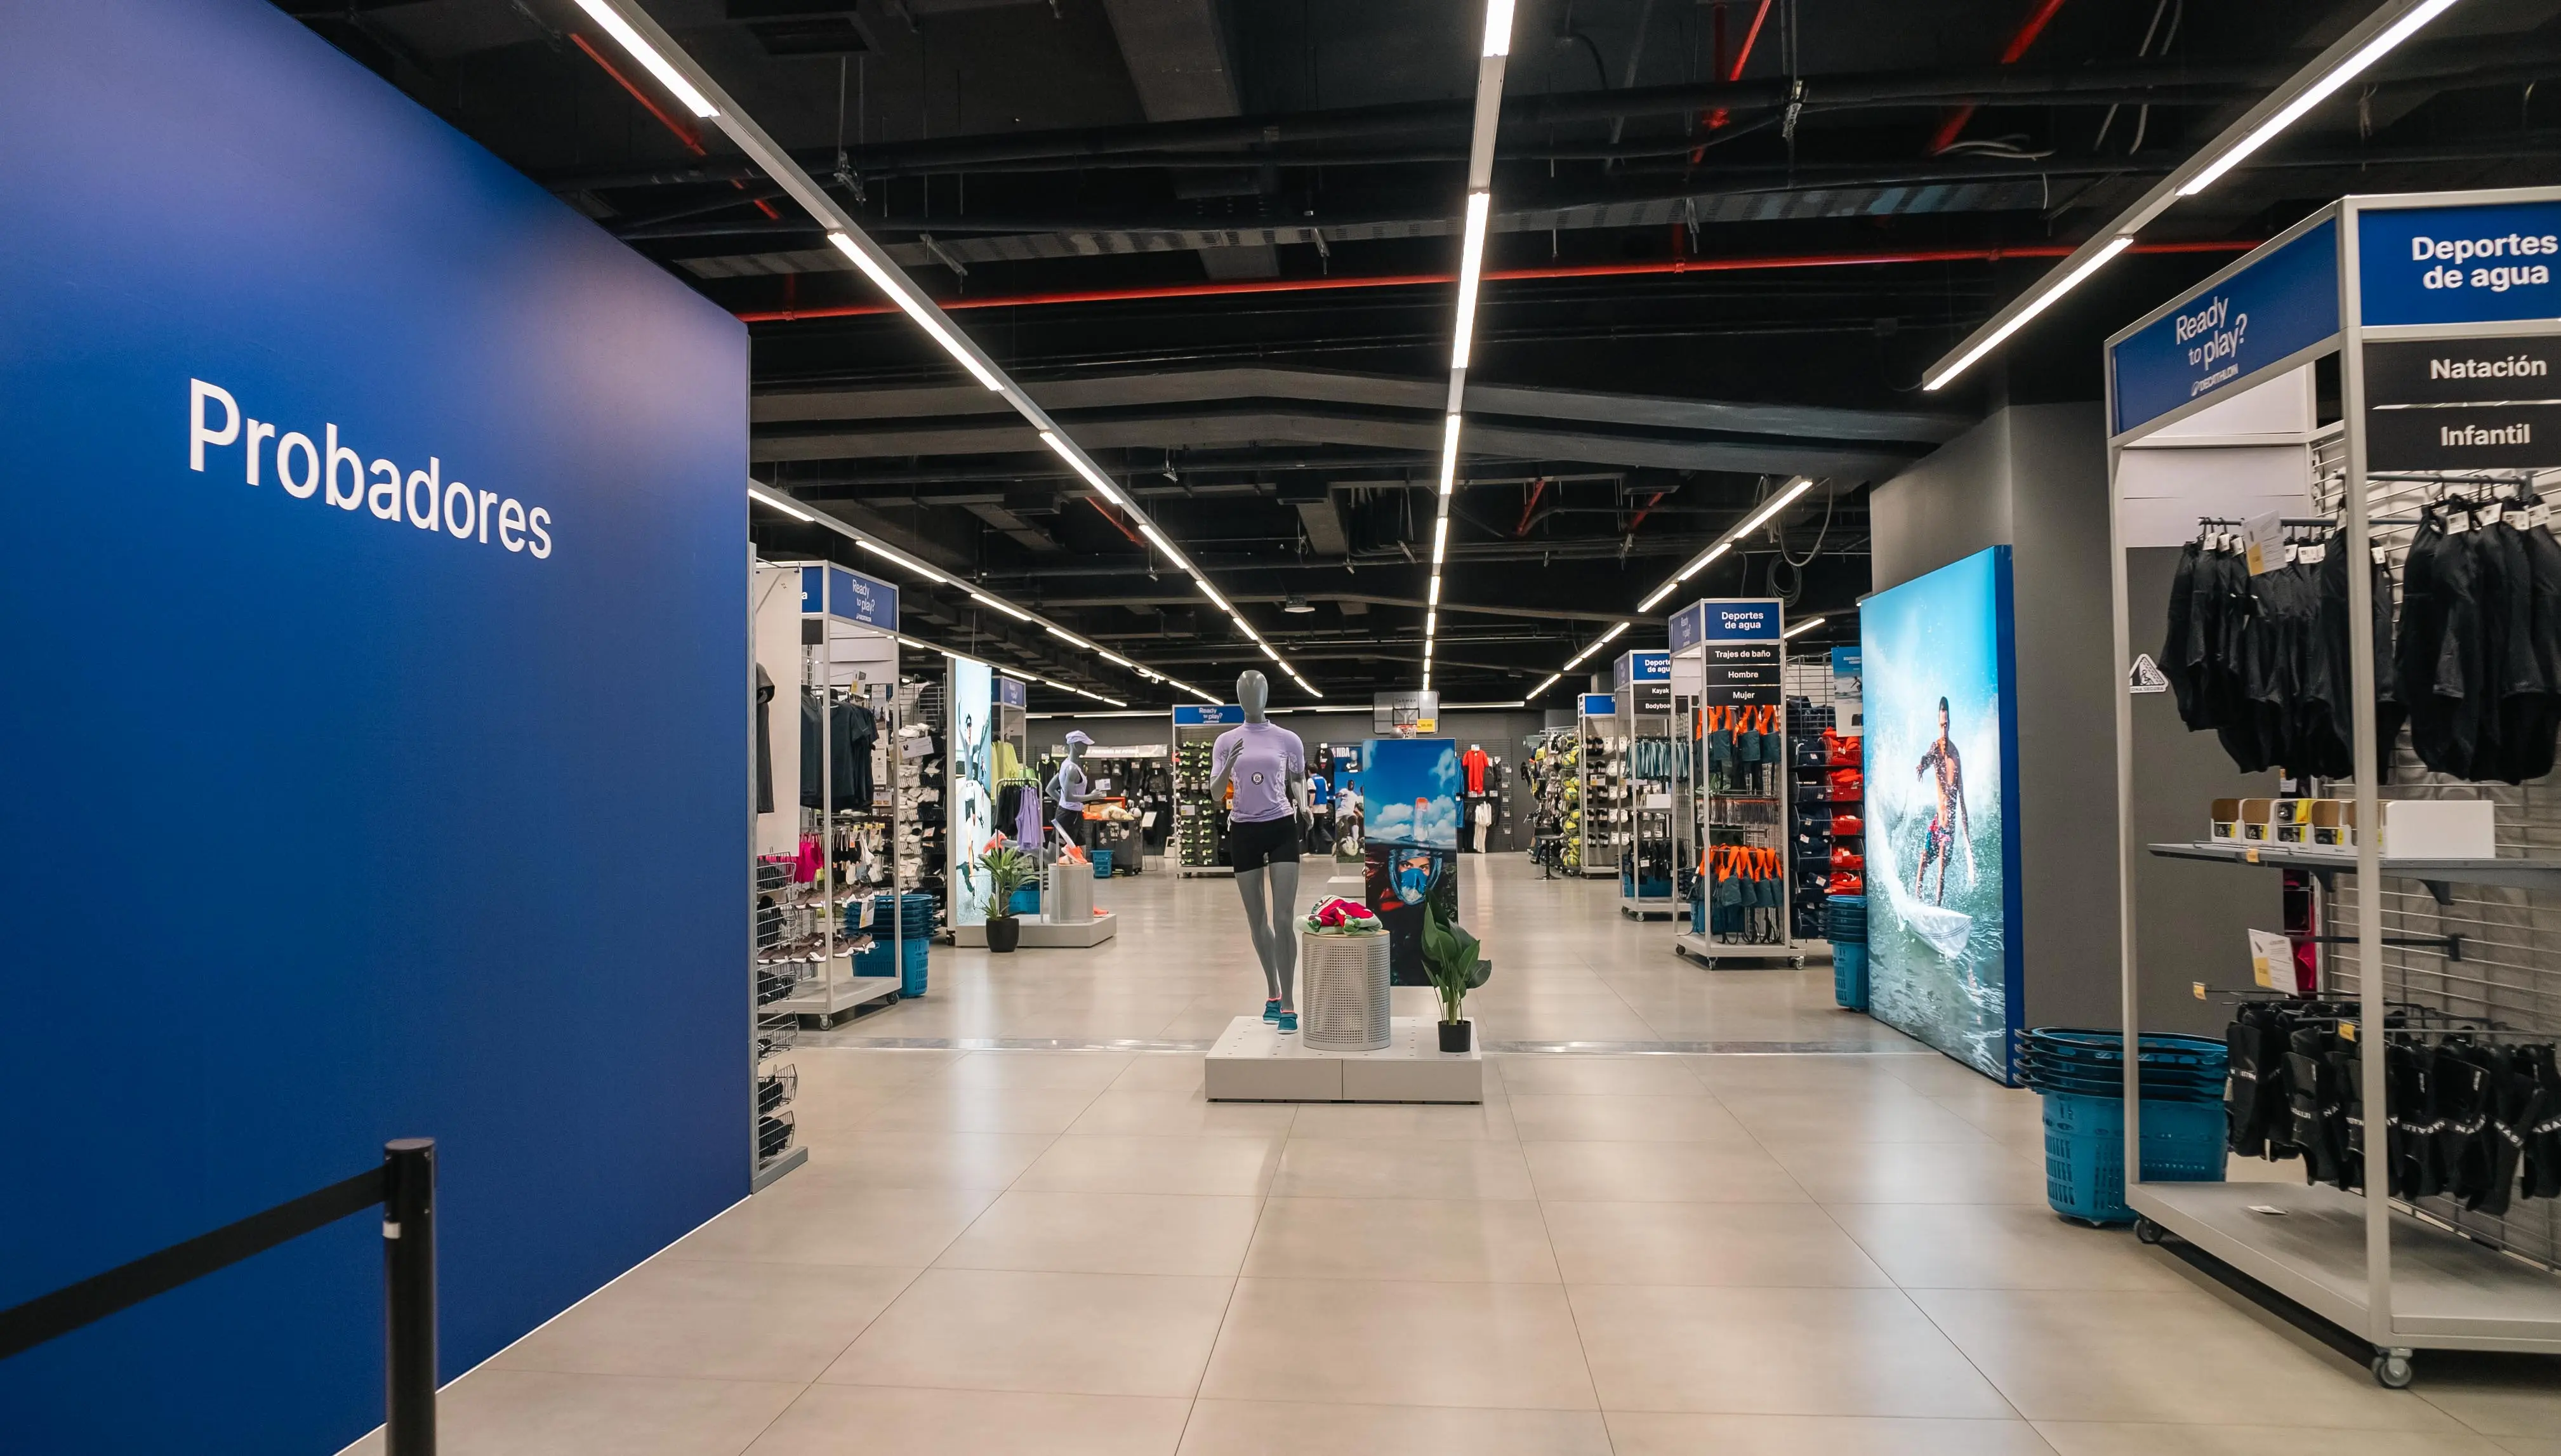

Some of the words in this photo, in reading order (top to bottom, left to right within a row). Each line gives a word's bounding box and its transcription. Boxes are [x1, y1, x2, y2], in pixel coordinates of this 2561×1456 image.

[2412, 234, 2558, 264] Deportes
[2423, 265, 2463, 289] de
[2470, 265, 2549, 293] agua
[2176, 295, 2229, 345] Ready
[2188, 348, 2202, 366] to
[2203, 313, 2248, 371] play?
[2430, 355, 2547, 379] Natación
[2440, 423, 2531, 446] Infantil
[190, 378, 552, 559] Probadores
[852, 579, 870, 599] Ready
[861, 599, 875, 615] play?
[1721, 612, 1764, 621] Deportes
[1738, 622, 1761, 630] agua
[1715, 651, 1738, 659] Trajes
[1733, 691, 1755, 699] Mujer
[1336, 747, 1350, 757] NBA
